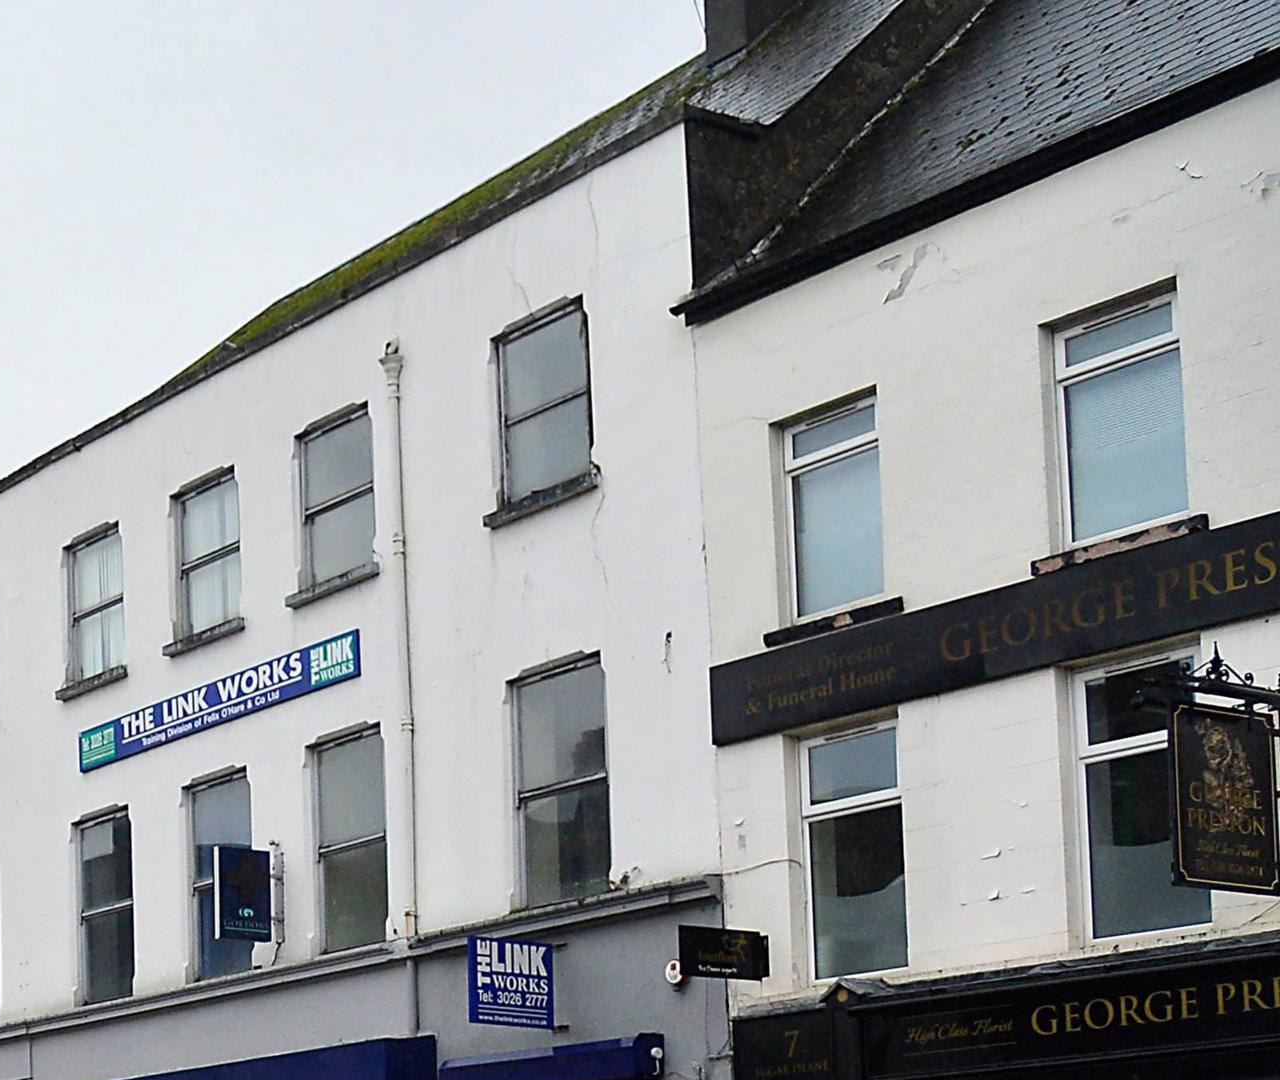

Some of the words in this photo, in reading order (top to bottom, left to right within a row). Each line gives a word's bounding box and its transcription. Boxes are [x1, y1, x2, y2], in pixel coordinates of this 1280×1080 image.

[942, 579, 1137, 663] GEORGE
[1156, 540, 1280, 609] PRES
[310, 647, 321, 686] THE
[320, 635, 354, 666] LINK
[320, 660, 355, 681] WORKS
[819, 642, 894, 673] Director
[120, 706, 155, 739] THE
[162, 686, 209, 723] LINK
[217, 652, 303, 703] WORKS
[167, 722, 193, 738] Division
[194, 718, 202, 728] of
[204, 711, 220, 725] Felix
[221, 703, 245, 718] O'Hare
[246, 700, 253, 709] &
[255, 696, 266, 706] Co
[267, 690, 280, 701] Ltd
[746, 698, 761, 715] &
[768, 677, 833, 710] Funeral
[841, 666, 896, 692] Home
[477, 939, 492, 988] THE
[491, 941, 548, 977] LINK
[492, 975, 549, 994] WORKS
[477, 989, 493, 1003] Tel:
[497, 991, 522, 1006] 3026
[525, 993, 548, 1008] 2777
[1031, 987, 1200, 1036] GEORGE
[784, 1030, 801, 1057] 7
[938, 1023, 969, 1040] Class
[970, 1018, 1015, 1037] Florist
